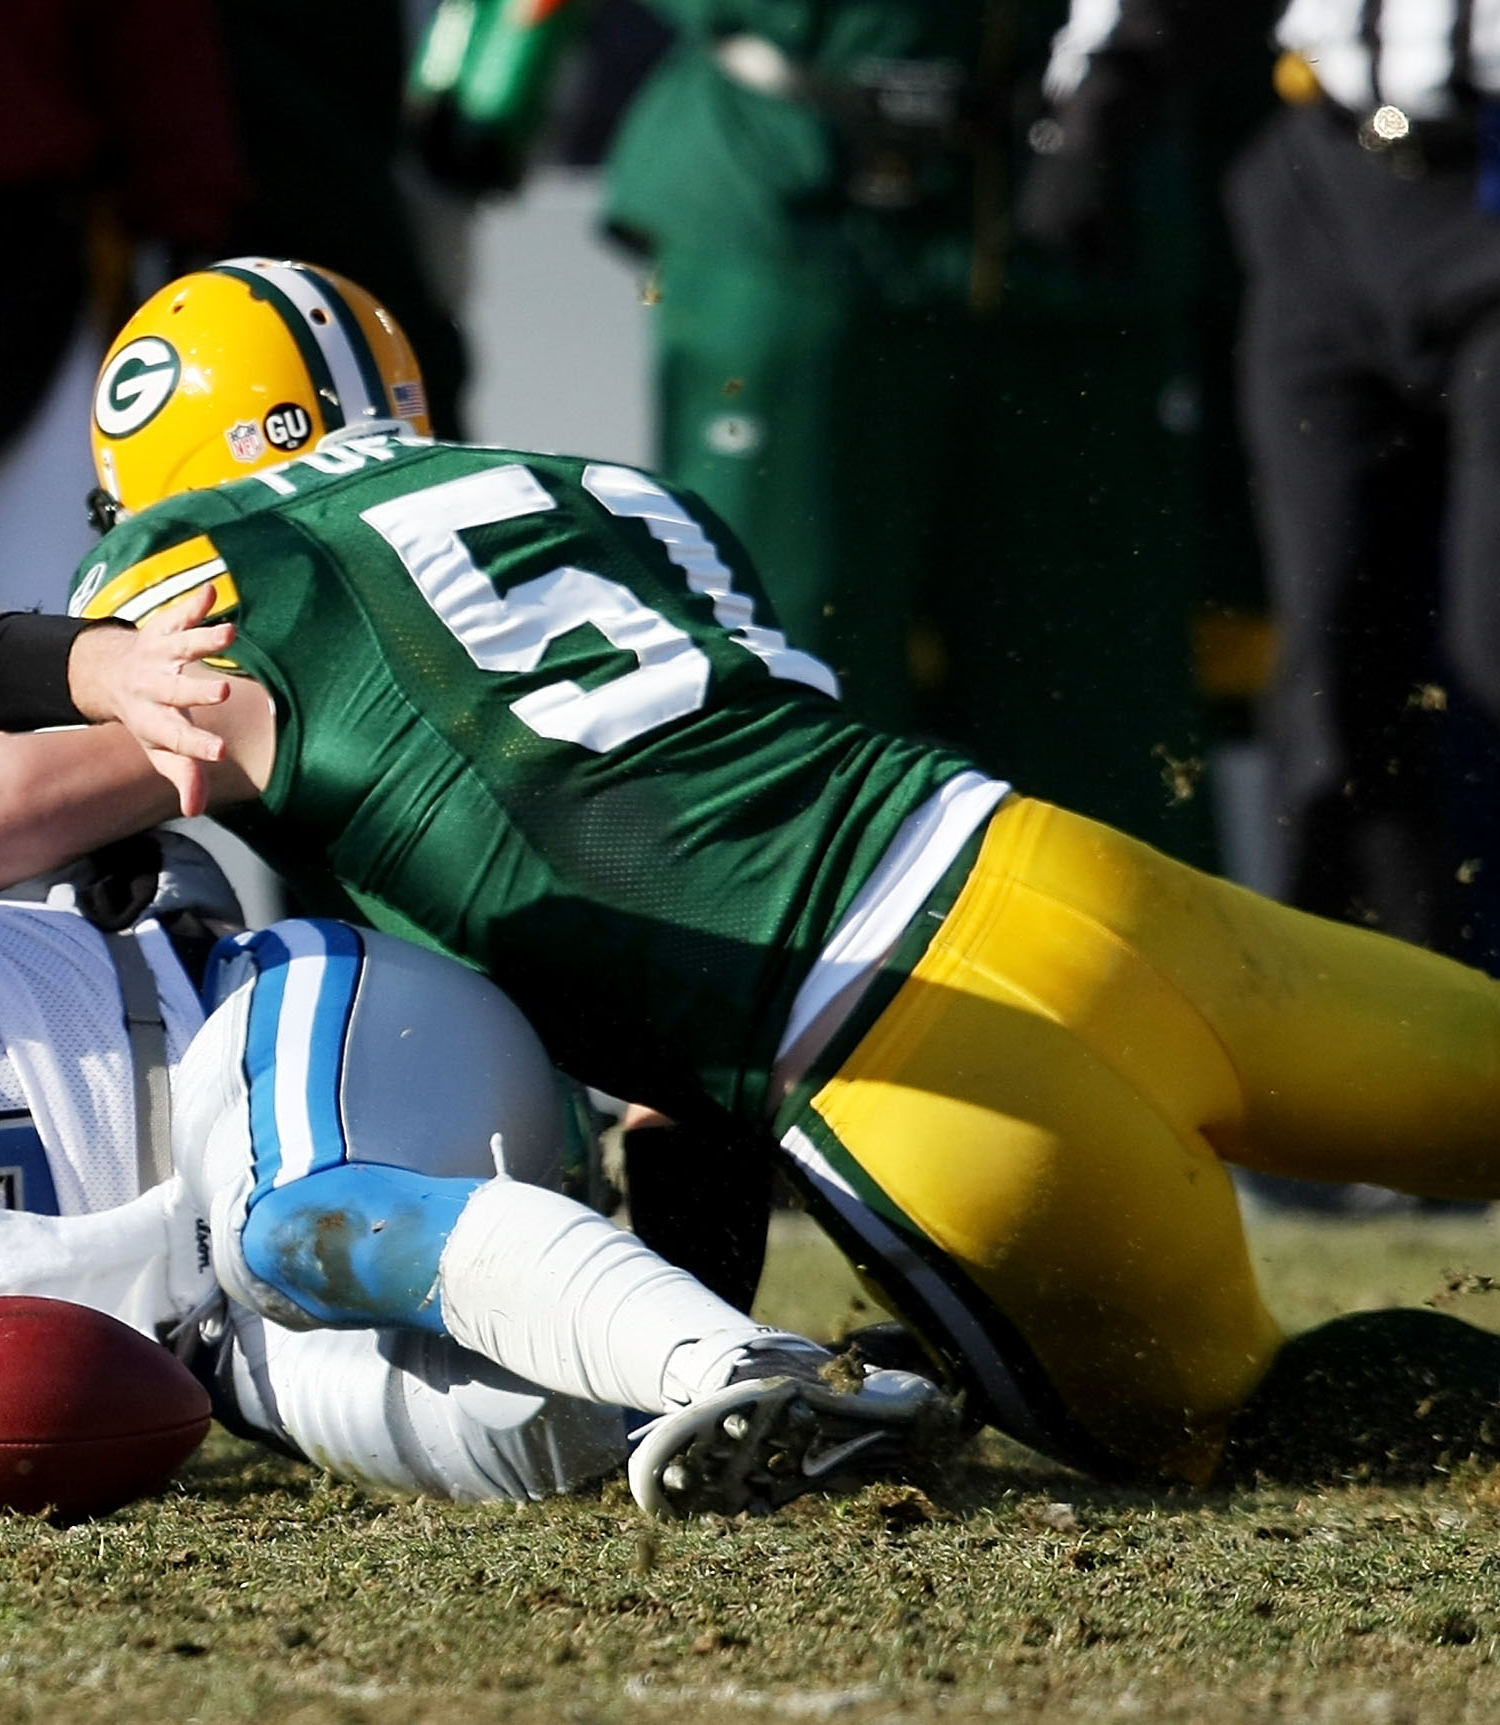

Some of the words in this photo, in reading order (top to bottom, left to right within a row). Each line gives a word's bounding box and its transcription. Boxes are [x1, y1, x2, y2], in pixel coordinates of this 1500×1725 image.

[96, 337, 176, 436] G
[265, 407, 308, 445] GU
[359, 464, 841, 754] 51
[195, 1217, 211, 1275] ilson
